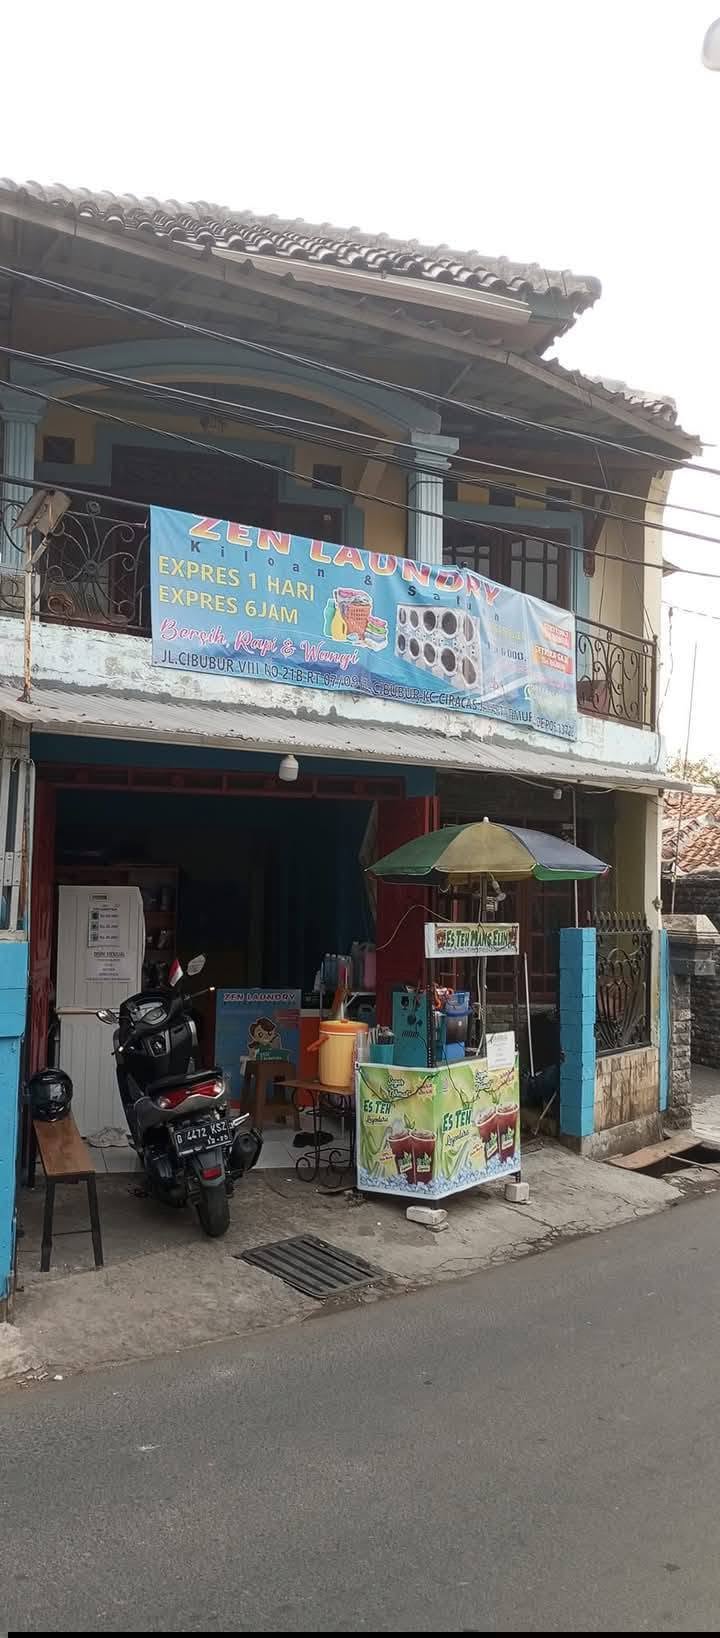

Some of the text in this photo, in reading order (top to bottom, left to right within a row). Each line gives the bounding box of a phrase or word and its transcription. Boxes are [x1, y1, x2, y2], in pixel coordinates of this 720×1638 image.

[189, 513, 502, 606] ZEN LAUNDRY
[158, 555, 316, 601] EXPRES 1 HARI
[158, 585, 300, 625] EXPRES 6JAM
[234, 630, 278, 656] Rapi
[280, 640, 297, 657] &
[300, 641, 360, 670] Wangi
[239, 659, 259, 675] VIII
[456, 930, 470, 947] TEH
[224, 992, 296, 1002] ZEN LAUNDRY
[363, 1099, 391, 1115] ES TEH
[442, 1109, 472, 1132] ES TEH
[187, 1127, 207, 1141] 4472
[210, 1122, 227, 1134] KSZ
